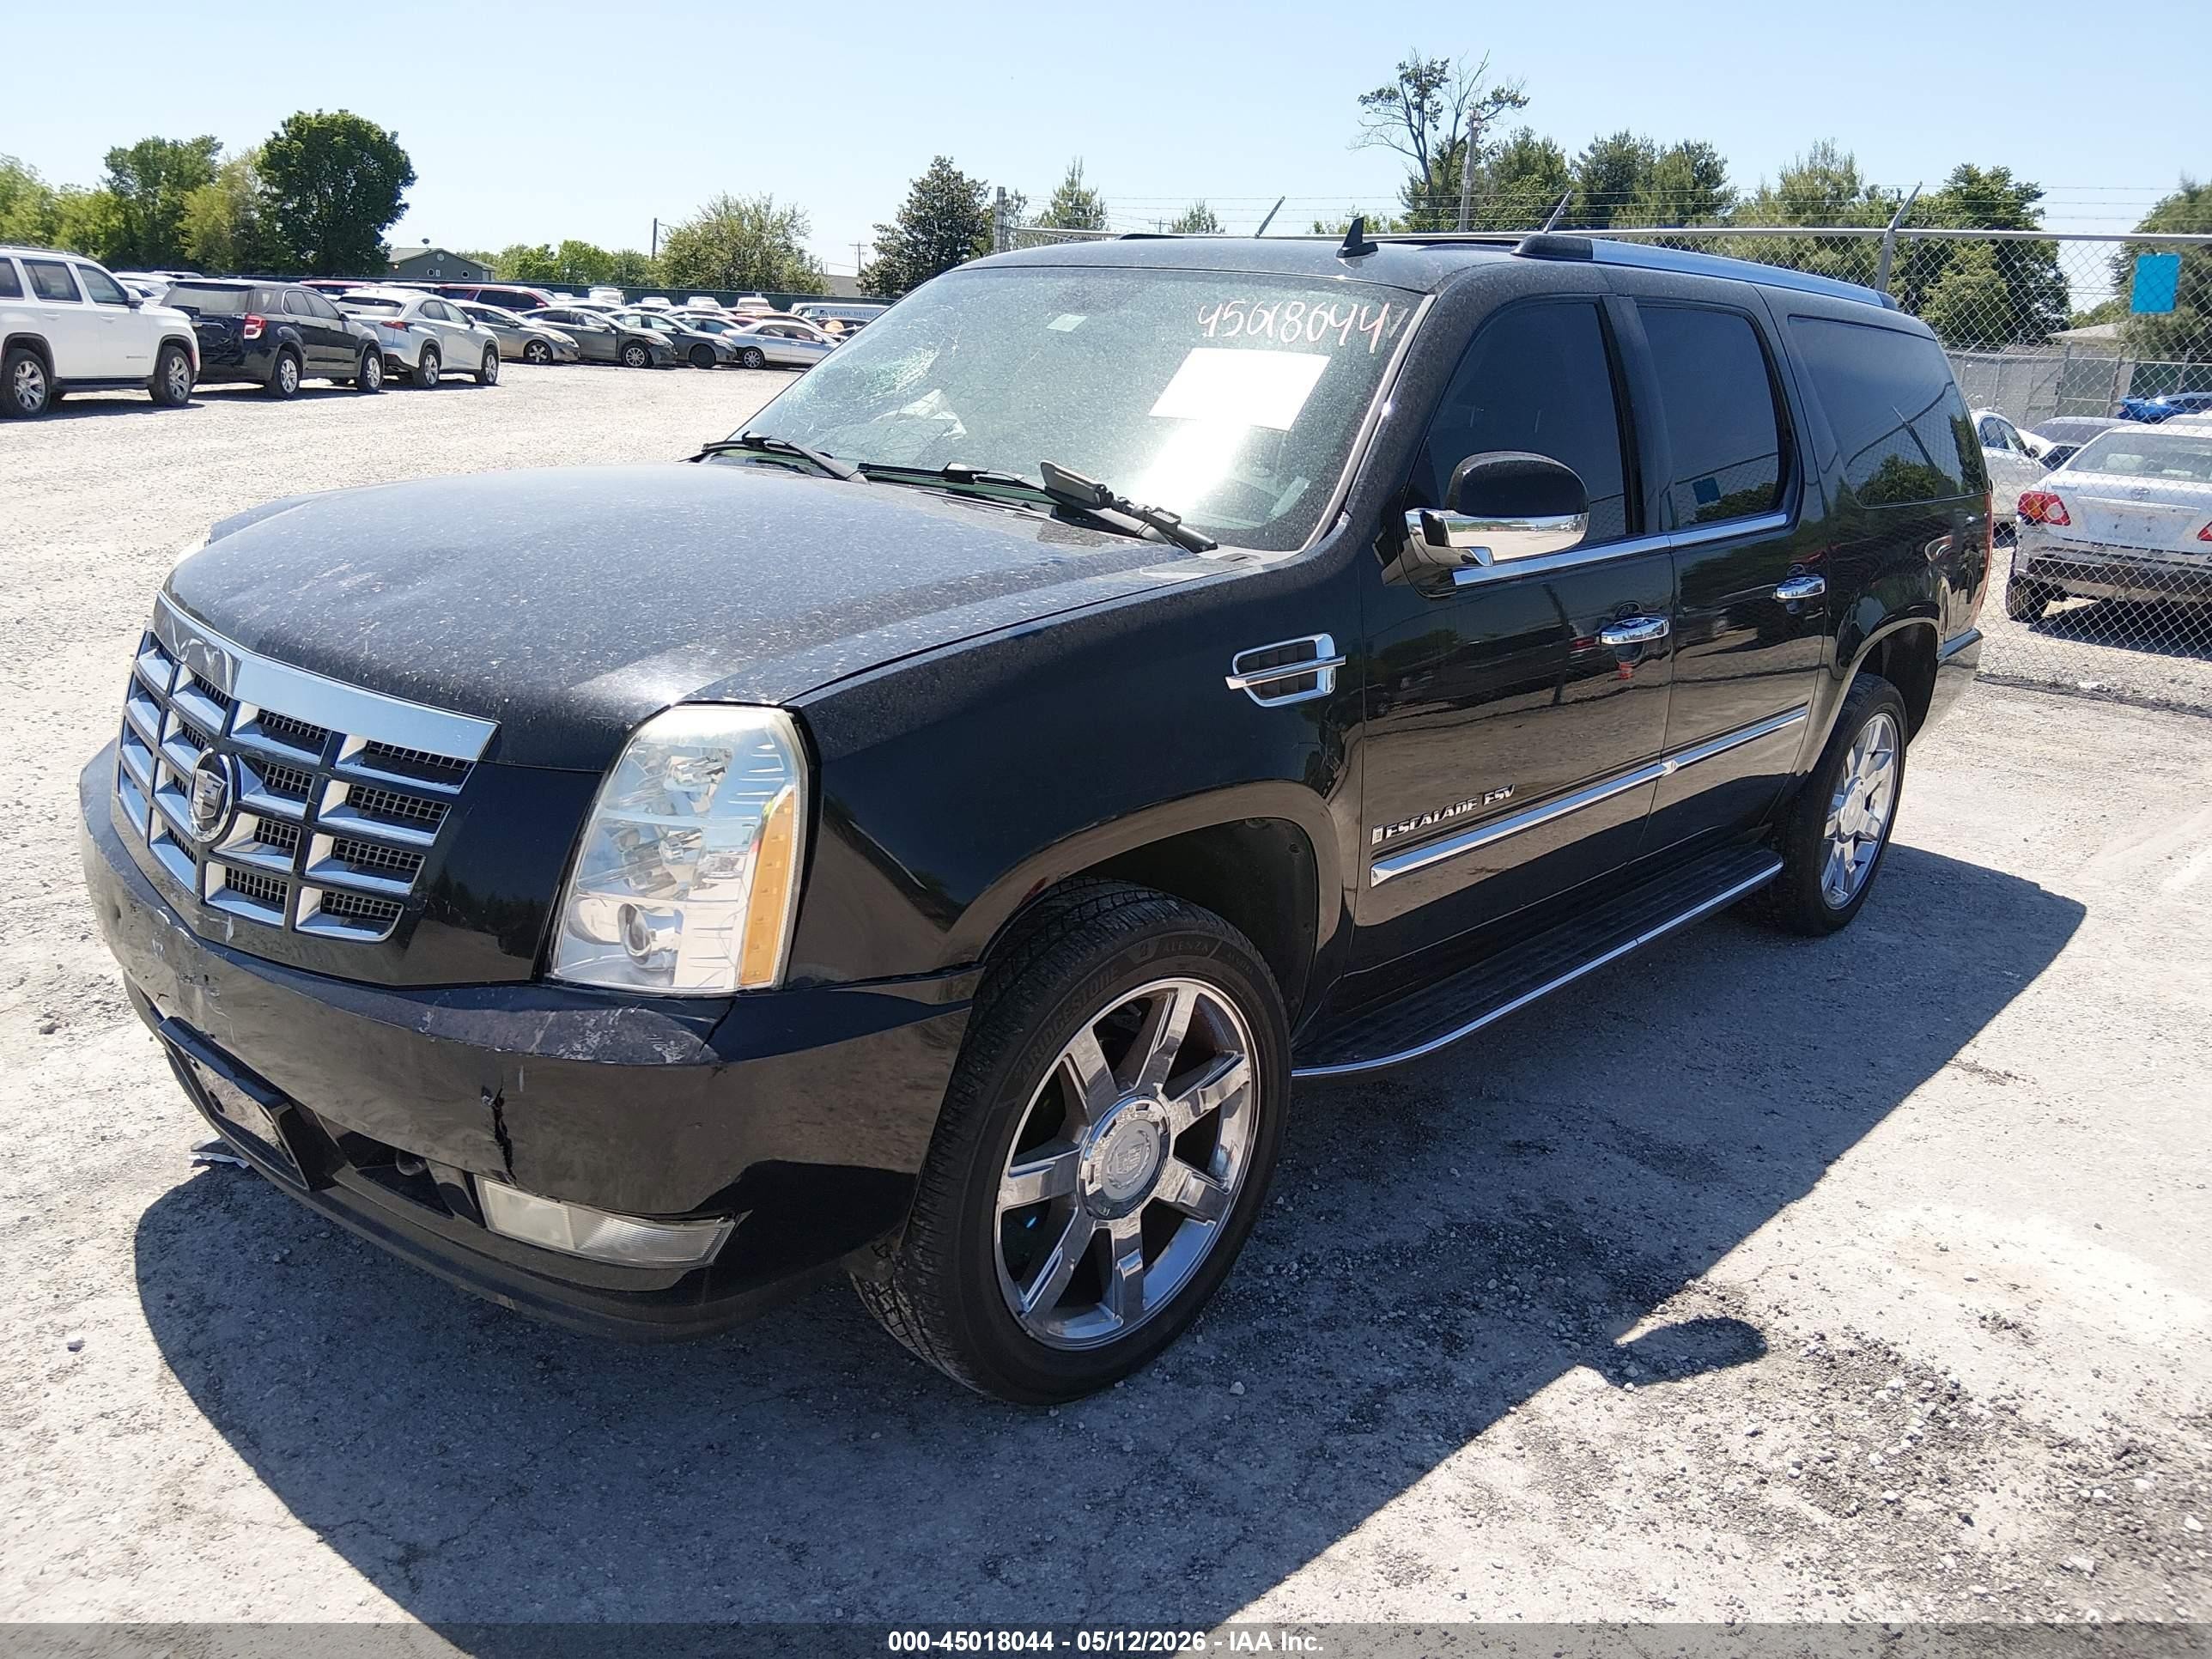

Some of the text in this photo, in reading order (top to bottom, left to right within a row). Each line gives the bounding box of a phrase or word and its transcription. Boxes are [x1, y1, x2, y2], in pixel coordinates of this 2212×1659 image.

[1196, 301, 1391, 354] 45018044
[1385, 784, 1516, 838] ESCALADE ESV
